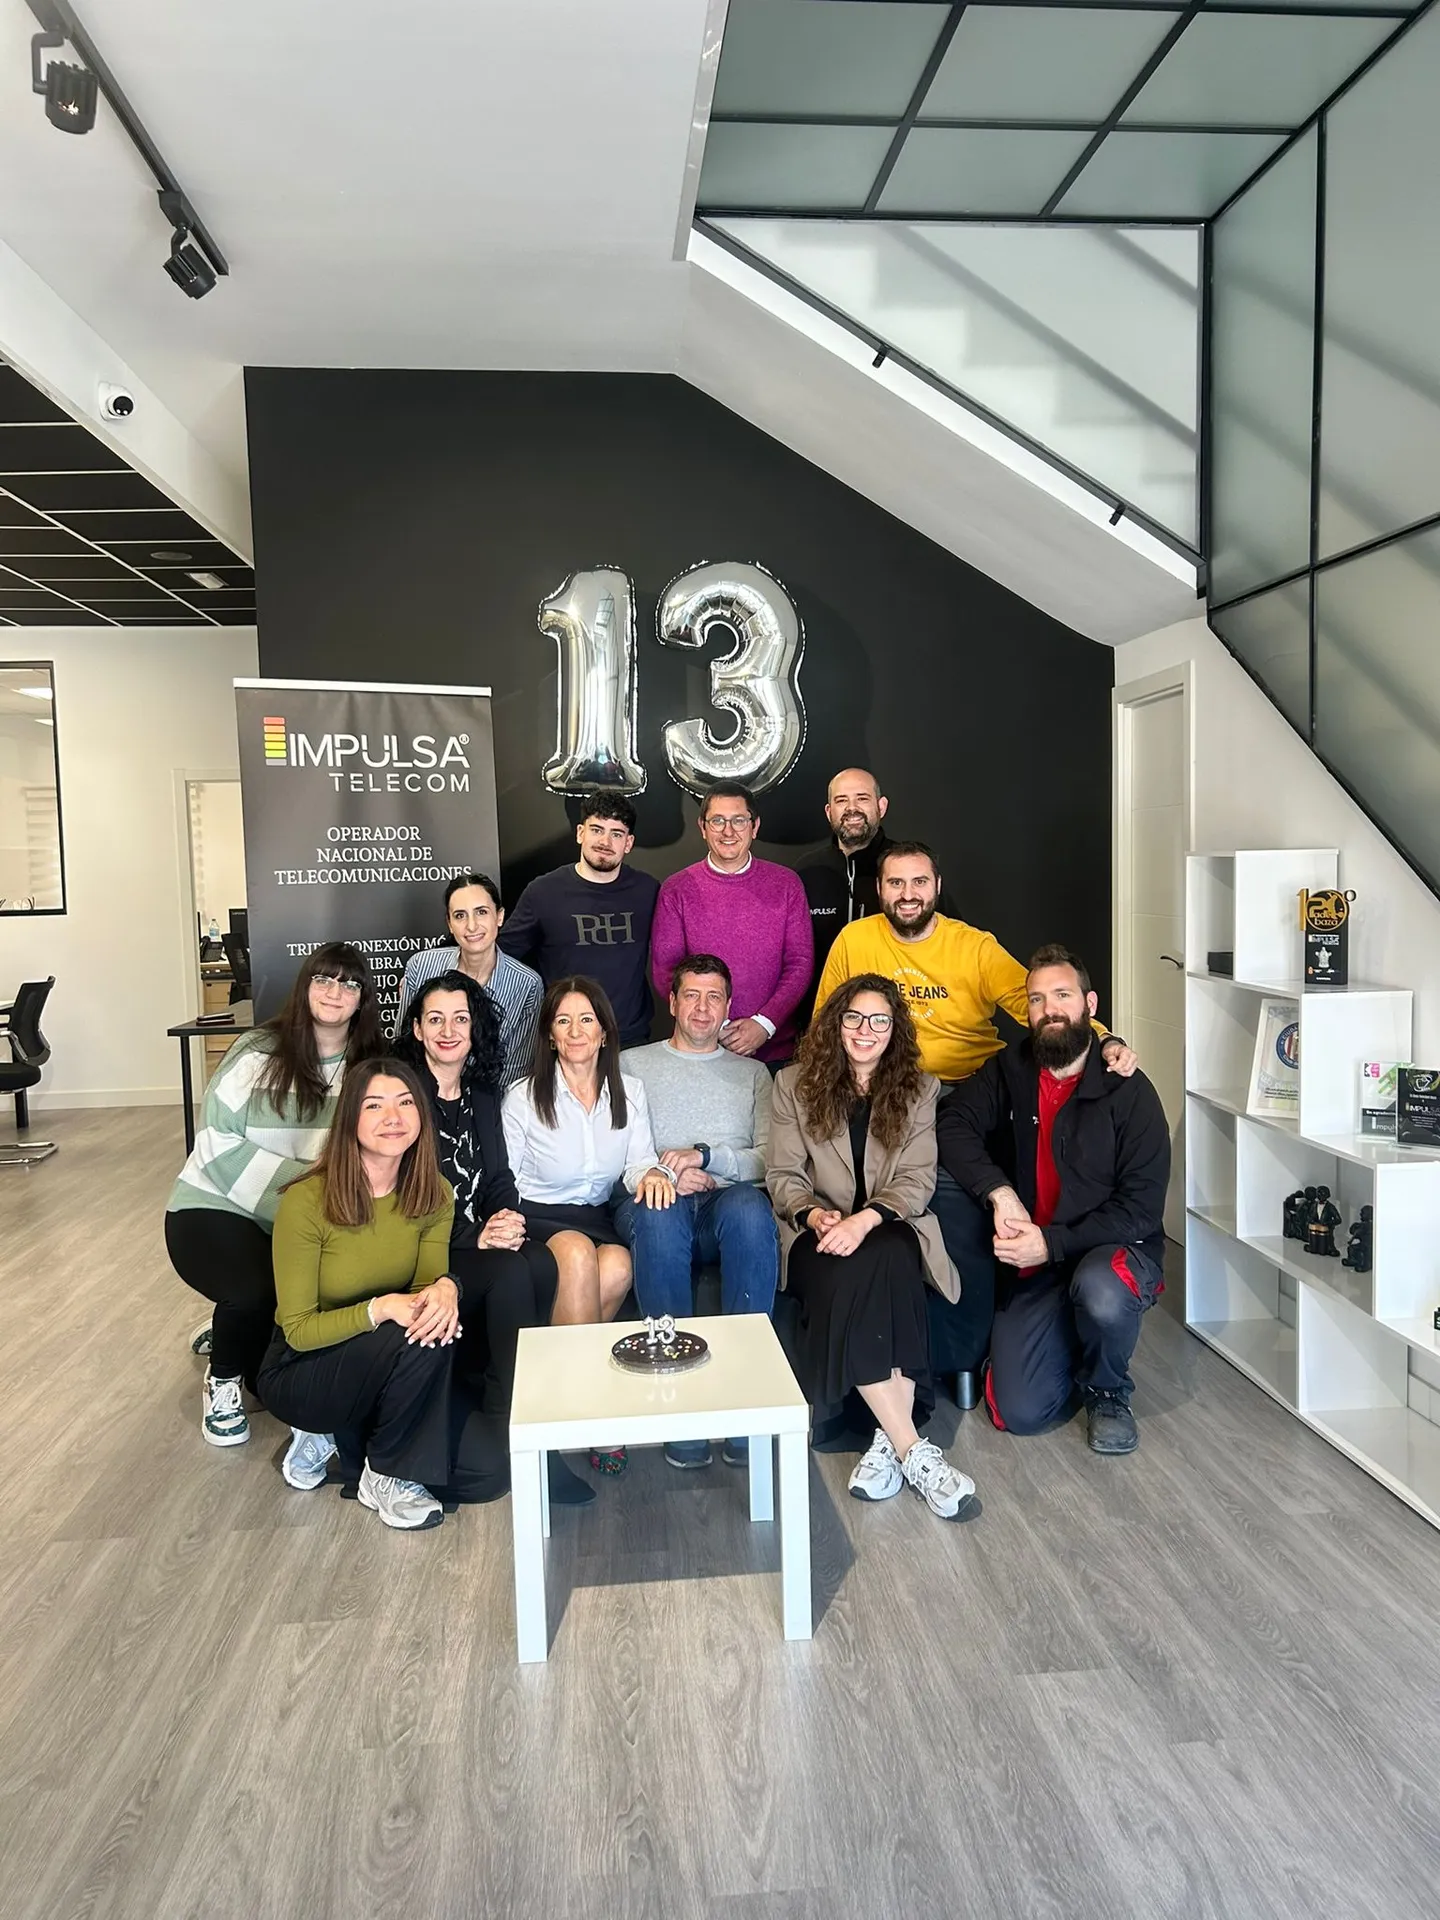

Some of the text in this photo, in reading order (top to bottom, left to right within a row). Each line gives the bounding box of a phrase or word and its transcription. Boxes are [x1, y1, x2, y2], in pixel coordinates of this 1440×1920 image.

[538, 560, 808, 799] 13
[328, 772, 471, 793] TELECOM
[326, 826, 422, 842] OPERADOR
[316, 847, 433, 863] NACIONAL DE
[366, 956, 404, 971] IBRA
[373, 974, 398, 989] IJO
[909, 985, 949, 999] JEANS
[643, 1313, 677, 1344] 13
